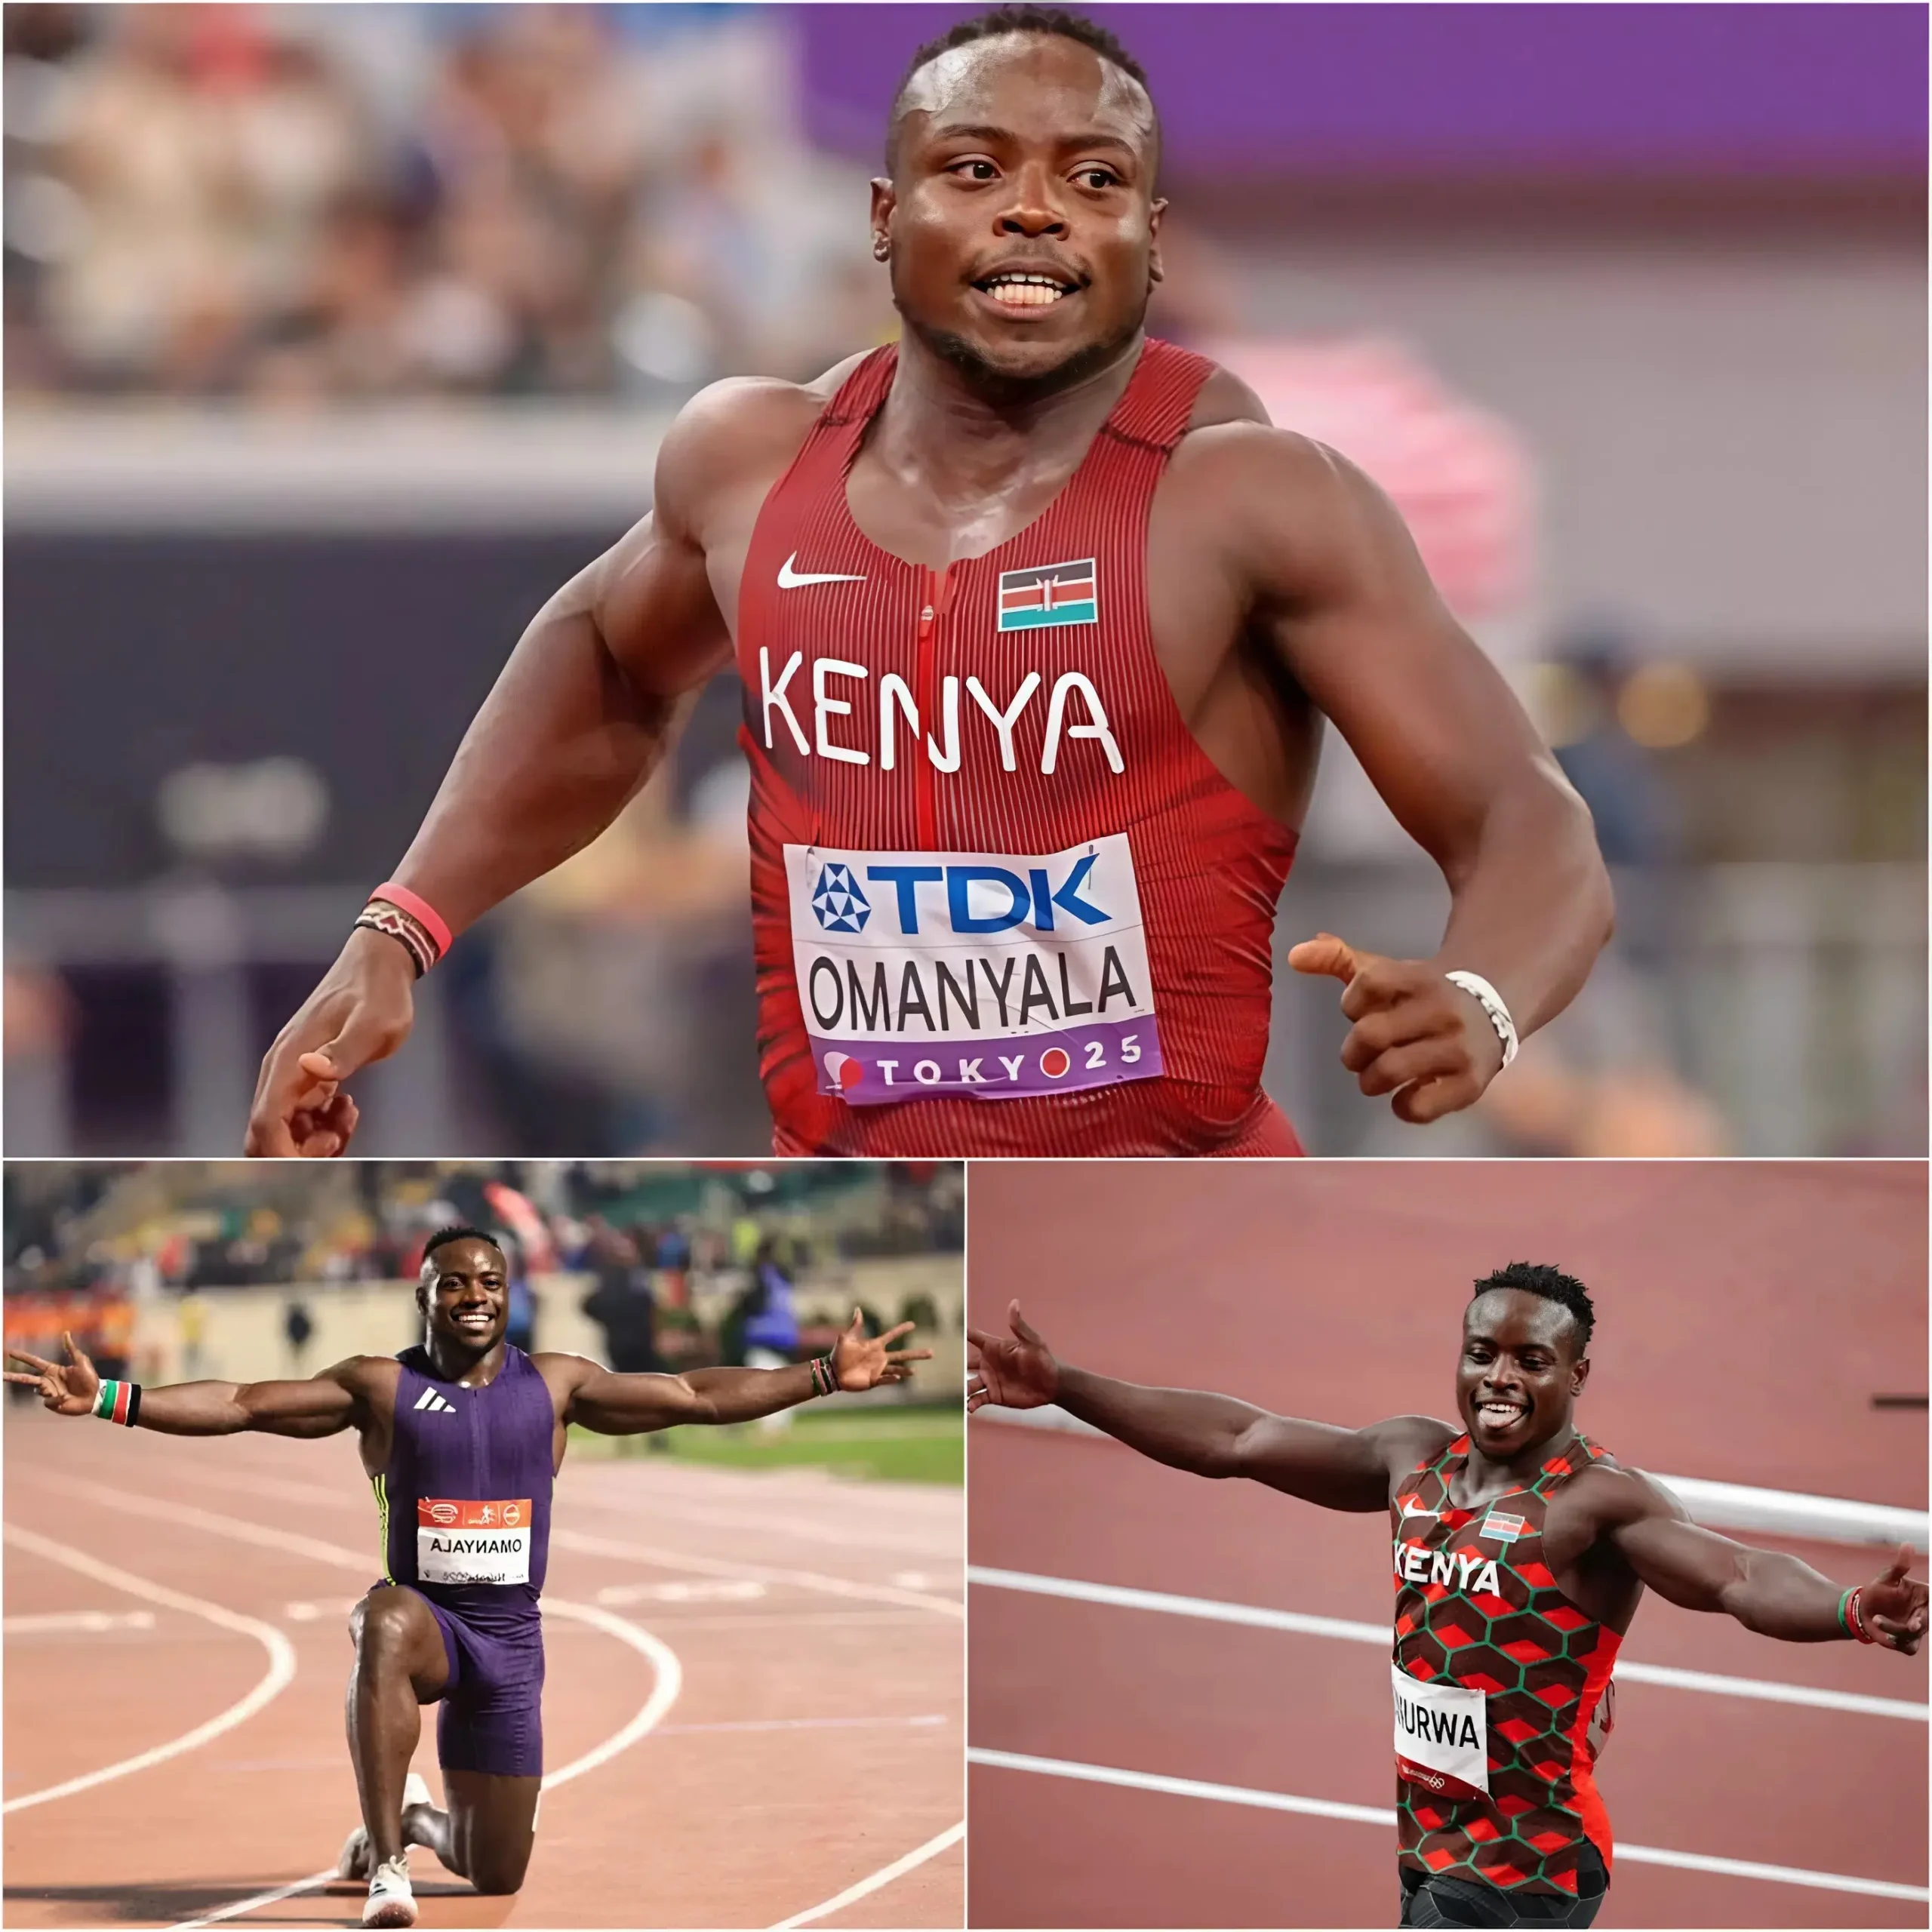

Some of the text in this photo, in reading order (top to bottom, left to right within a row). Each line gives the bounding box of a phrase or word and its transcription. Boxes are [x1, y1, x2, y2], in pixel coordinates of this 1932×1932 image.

[758, 646, 1124, 775] KENYA
[866, 853, 1113, 935] TDK
[808, 945, 1137, 1032] OMANYALA
[1083, 1034, 1142, 1070] 25
[1394, 1542, 1501, 1598] KENYA
